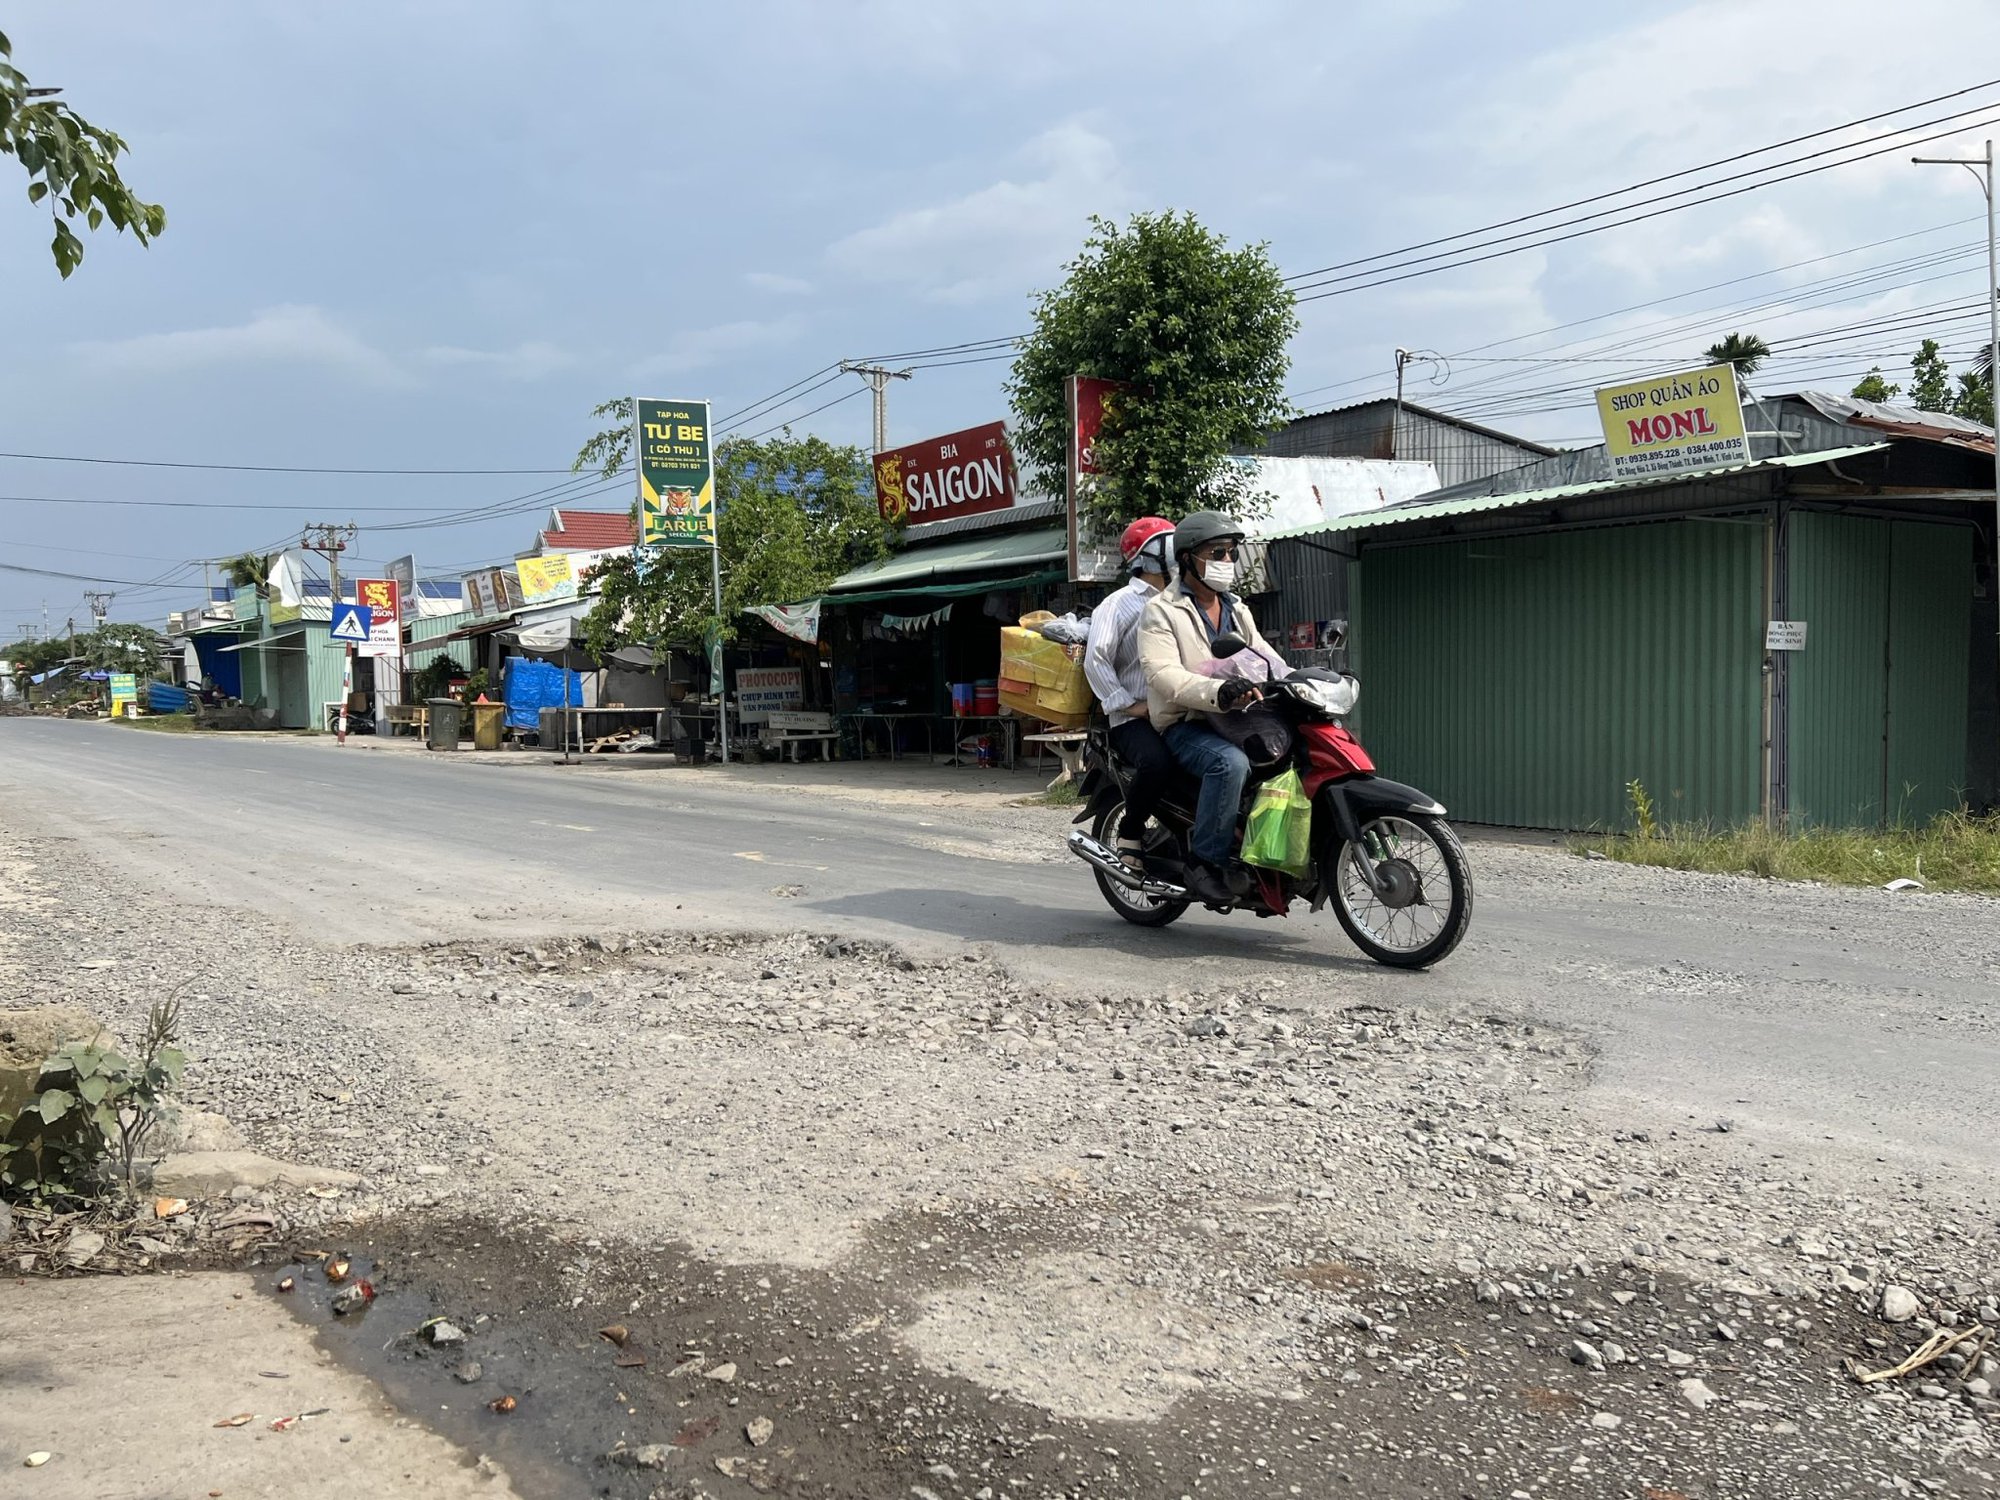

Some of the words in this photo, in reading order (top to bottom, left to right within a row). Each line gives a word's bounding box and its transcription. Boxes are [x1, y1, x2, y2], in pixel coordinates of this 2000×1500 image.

[1611, 391, 1646, 411] SHOP
[1650, 378, 1693, 406] QUẦN
[1698, 375, 1720, 396] ÁO
[644, 423, 672, 440] TƯ
[1627, 407, 1715, 445] MONL
[656, 444, 671, 454] CÔ
[673, 446, 693, 455] THU
[940, 443, 959, 460] BIA
[1615, 457, 1628, 466] ĐT:
[1629, 449, 1680, 463] 0939.895.228
[1687, 438, 1742, 455] 0384.400.035
[907, 460, 917, 468] EST.
[906, 454, 1004, 512] SAIGON
[654, 519, 708, 532] LARUE
[738, 671, 800, 688] PHOTOCOPY
[741, 692, 762, 703] CHỤP
[763, 690, 783, 700] HÌNH
